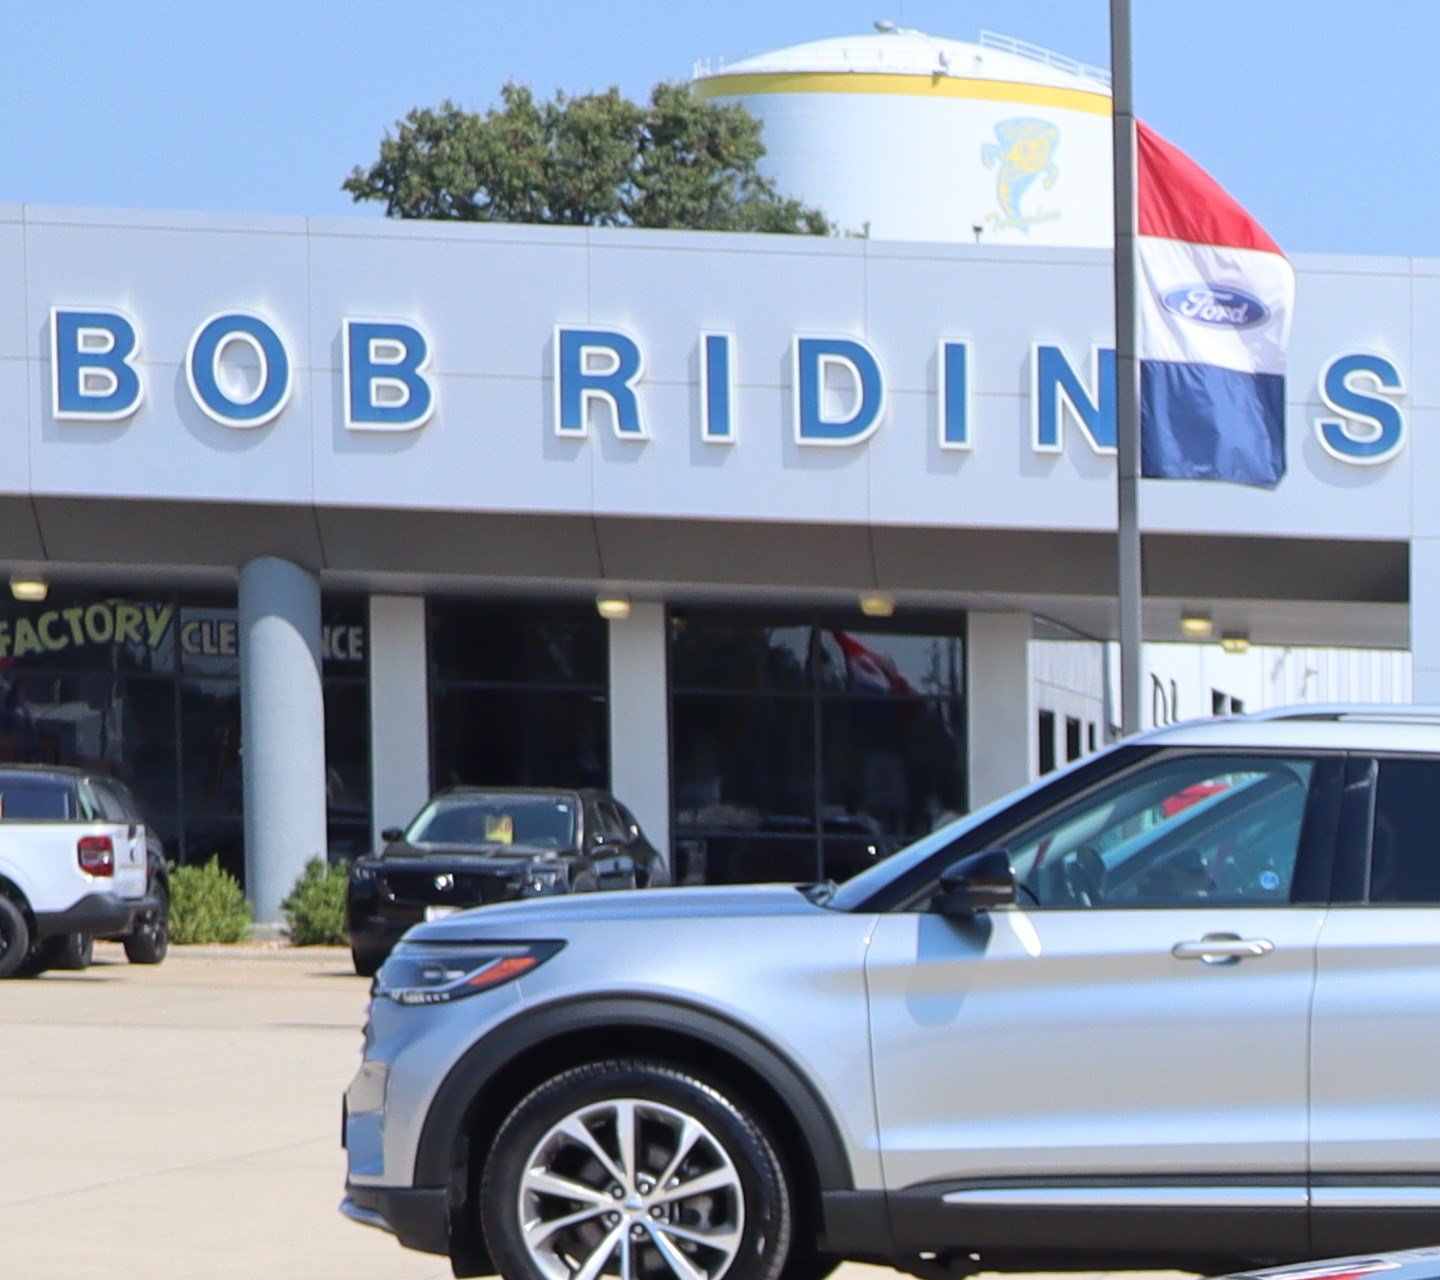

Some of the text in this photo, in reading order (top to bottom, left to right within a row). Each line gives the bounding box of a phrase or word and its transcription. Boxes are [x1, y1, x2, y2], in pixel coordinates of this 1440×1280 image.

[1180, 289, 1249, 323] Ford
[50, 304, 1407, 465] BOB RIDINS
